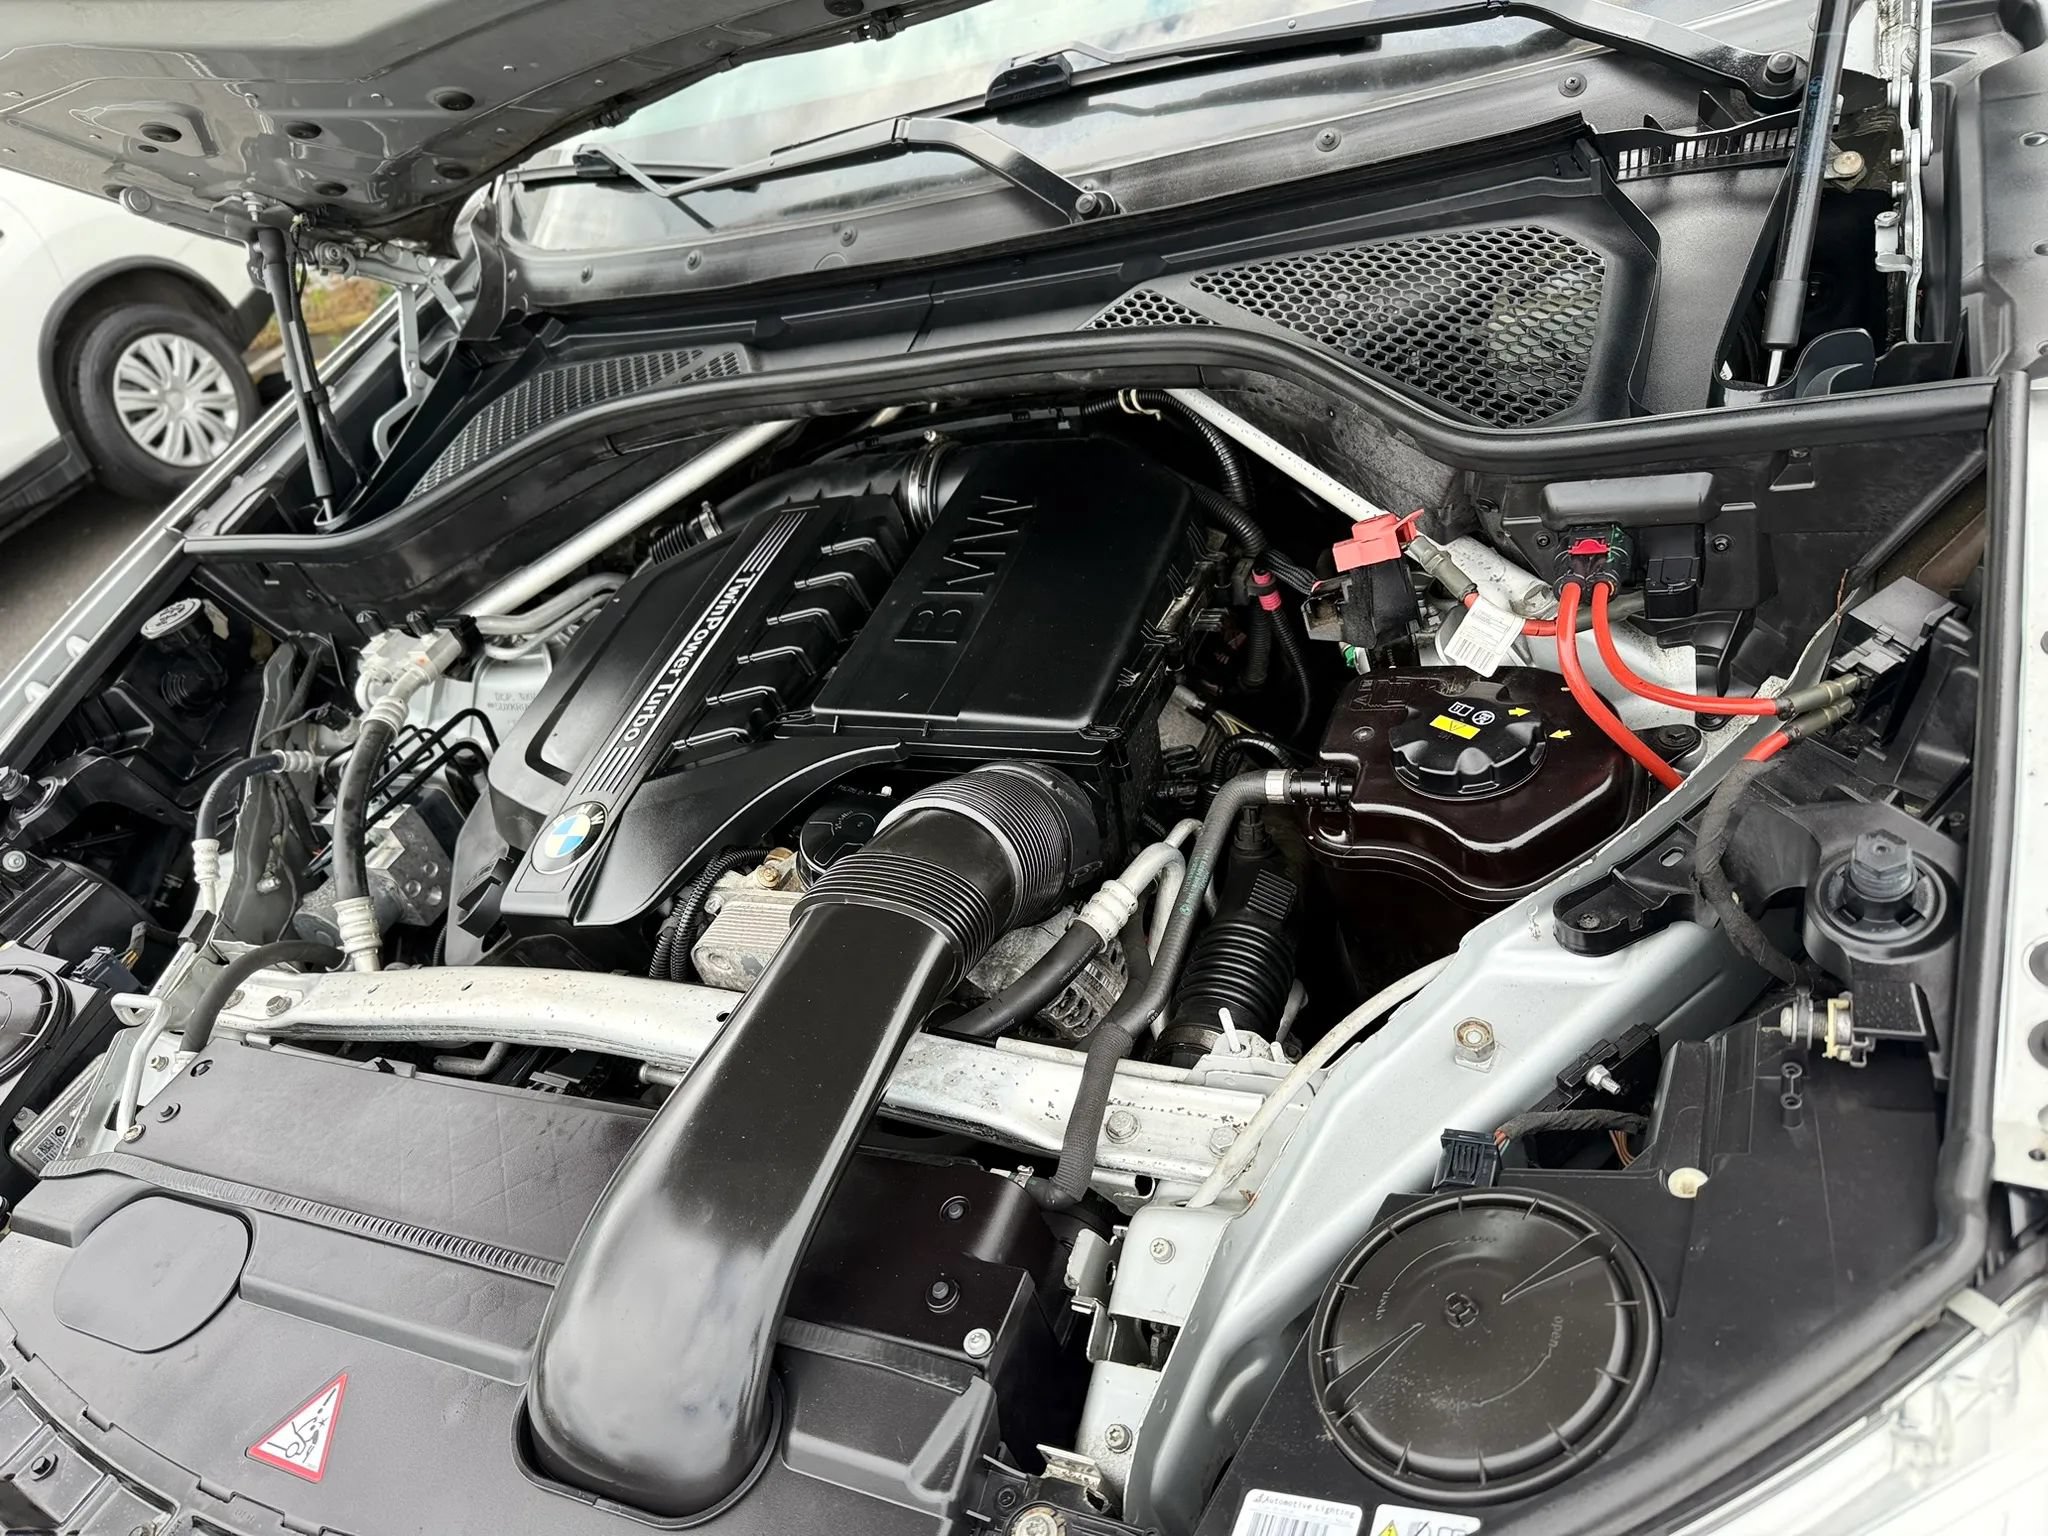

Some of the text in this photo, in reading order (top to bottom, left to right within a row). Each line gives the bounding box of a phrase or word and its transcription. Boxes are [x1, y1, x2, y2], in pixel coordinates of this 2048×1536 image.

[893, 495, 1033, 644] BMW
[1548, 1315, 1565, 1348] open
[1264, 1495, 1356, 1520] Automotive Lighting
